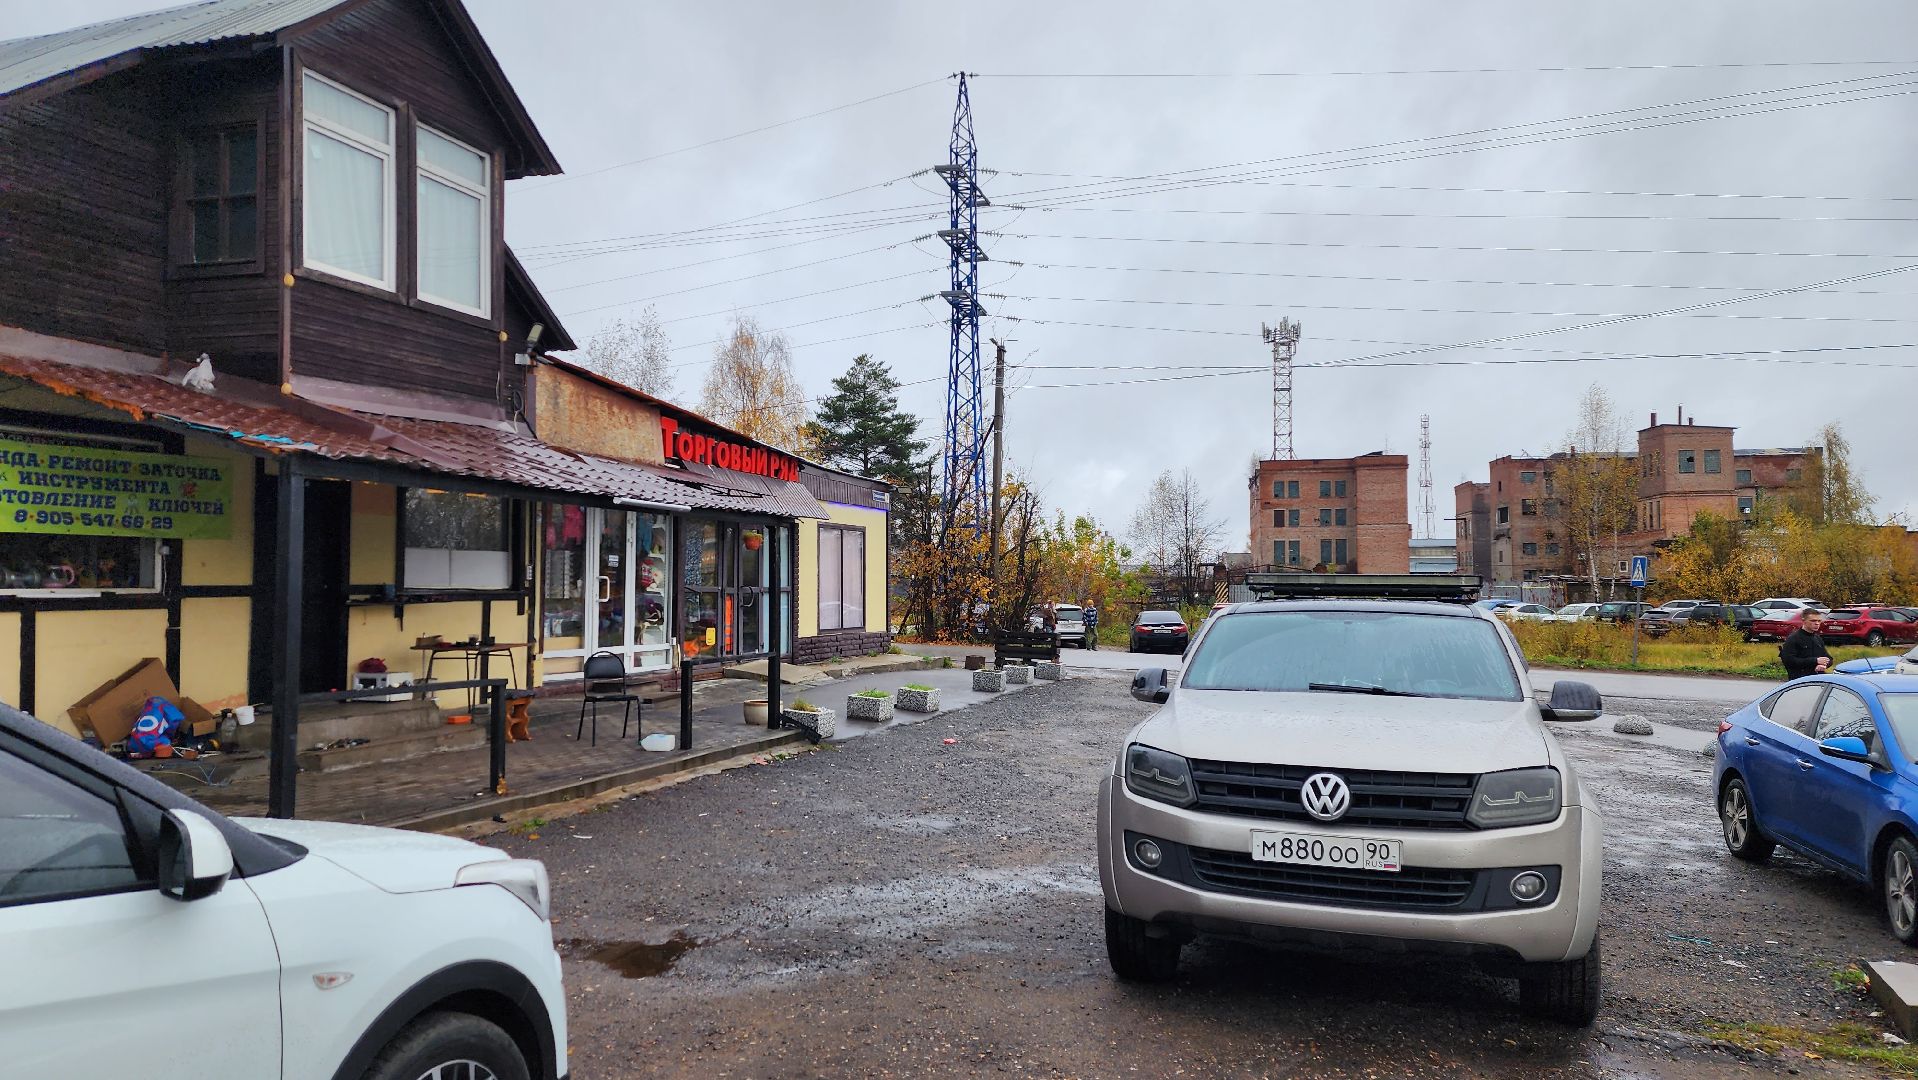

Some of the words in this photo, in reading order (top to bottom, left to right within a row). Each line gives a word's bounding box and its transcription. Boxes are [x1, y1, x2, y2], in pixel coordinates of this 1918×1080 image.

[48, 455, 132, 475] РЕМОНТ
[139, 462, 221, 481] ЗАТОЧКА
[18, 470, 171, 495] ИНСТРУМЕНТА
[0, 489, 117, 510] ТОВЛЕНИЕ
[148, 498, 225, 515] КЛЮЧЕЙ
[15, 509, 28, 523] 8
[36, 510, 74, 526] 905
[80, 513, 115, 527] 547
[151, 516, 173, 530] 29
[1366, 842, 1390, 861] 90
[1365, 860, 1383, 868] RUS
